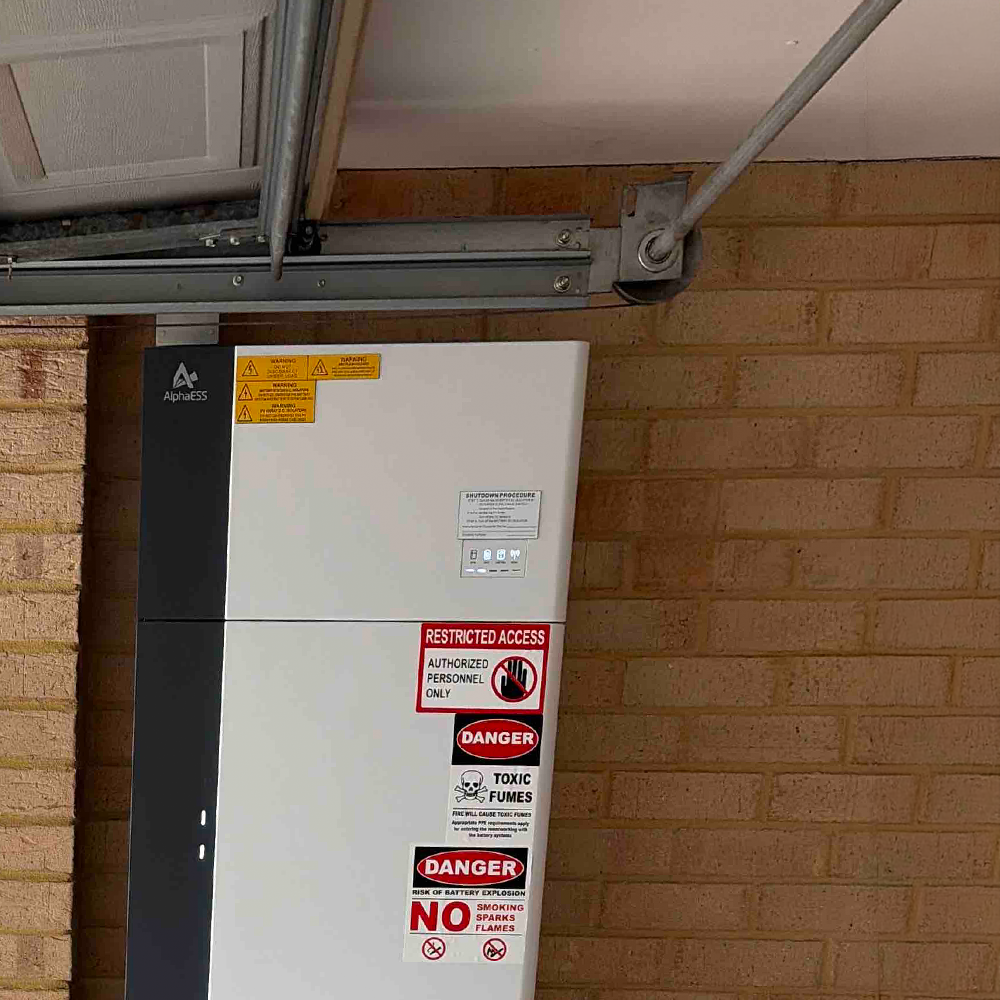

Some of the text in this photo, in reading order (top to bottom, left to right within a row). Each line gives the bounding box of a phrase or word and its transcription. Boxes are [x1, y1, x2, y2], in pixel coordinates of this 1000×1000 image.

[164, 390, 208, 403] AlphaESS
[425, 629, 545, 645] RESTRICTED ACCESS
[428, 658, 488, 669] AUTHORIZED
[427, 673, 484, 684] PERSONNEL
[426, 688, 451, 698] ONLY
[461, 731, 534, 745] DANGER
[494, 773, 531, 785] TOXIC
[489, 791, 532, 803] FUMES
[424, 860, 517, 876] DANGER
[410, 901, 471, 932] NO
